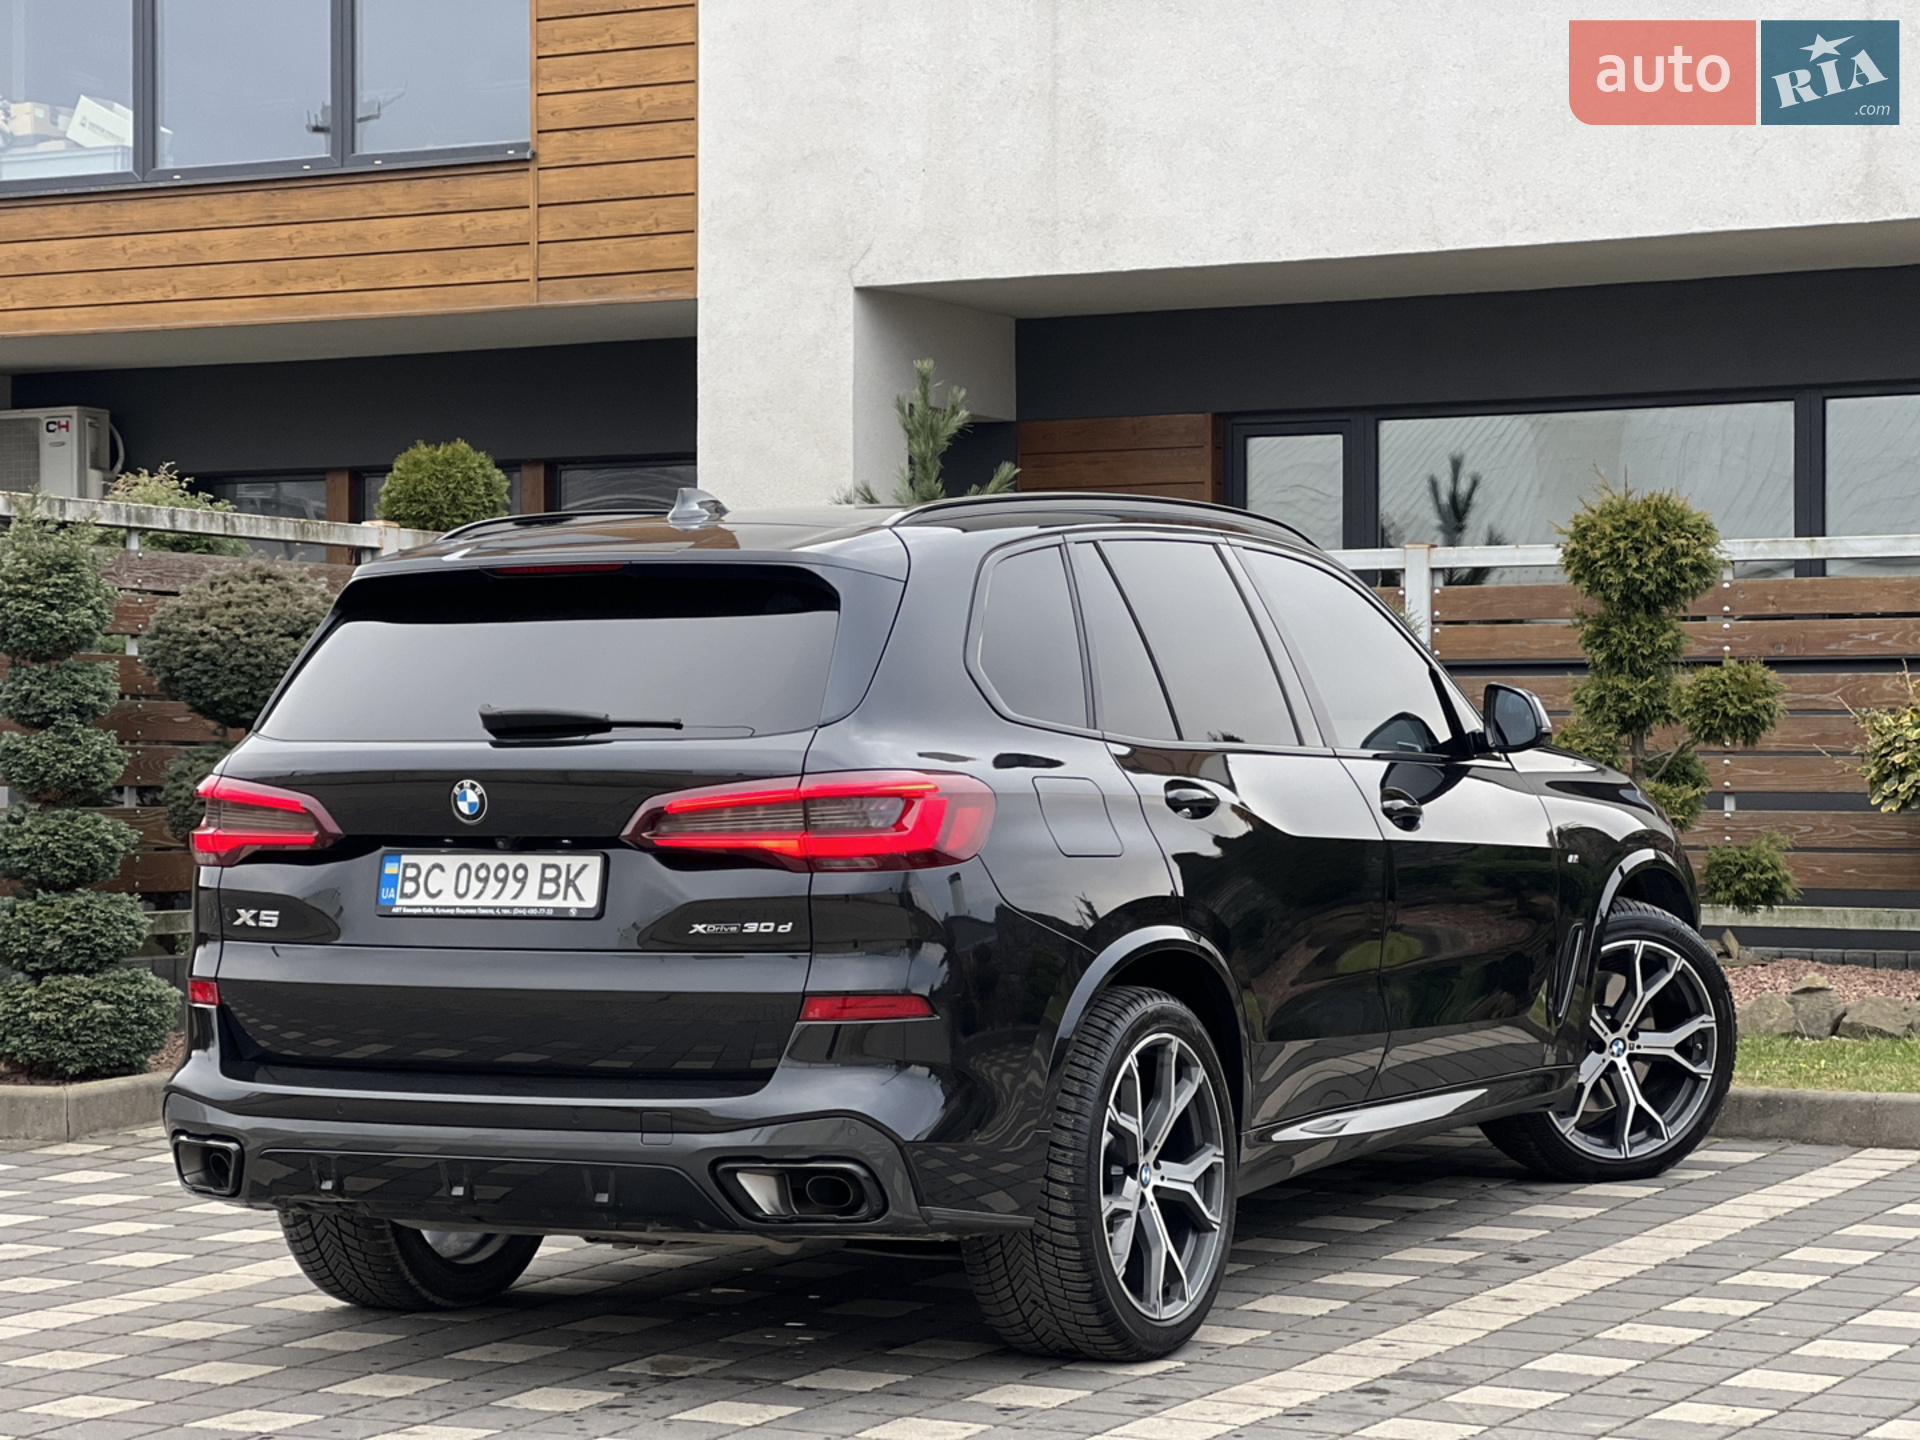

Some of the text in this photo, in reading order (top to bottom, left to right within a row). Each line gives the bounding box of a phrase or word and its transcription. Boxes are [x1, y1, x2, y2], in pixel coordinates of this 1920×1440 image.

[45, 420, 70, 433] CH
[399, 862, 589, 902] BC 0999 BK
[381, 888, 396, 899] UA
[232, 909, 280, 927] X5
